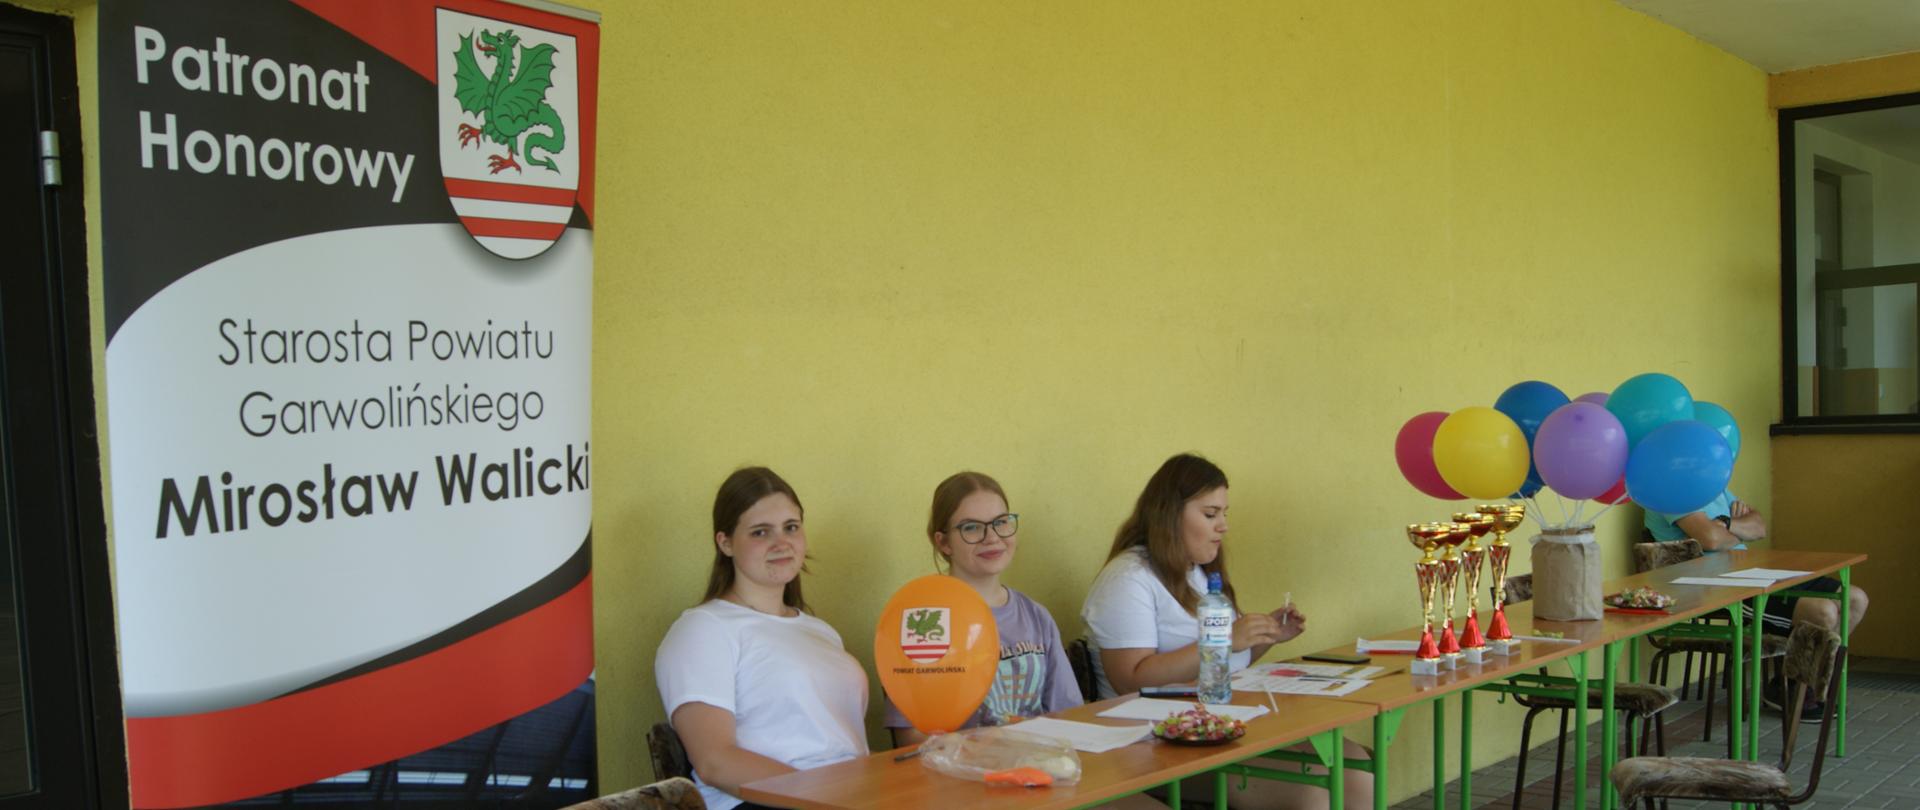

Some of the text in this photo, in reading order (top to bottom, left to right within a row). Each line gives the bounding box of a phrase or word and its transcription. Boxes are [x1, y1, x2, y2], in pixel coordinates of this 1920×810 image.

[134, 25, 370, 113] Patronat
[139, 110, 415, 202] Honorowy
[218, 317, 554, 366] Starosta Powiatu
[239, 382, 544, 438] Garwolińskiego
[155, 441, 590, 539] Mirosław Walicki
